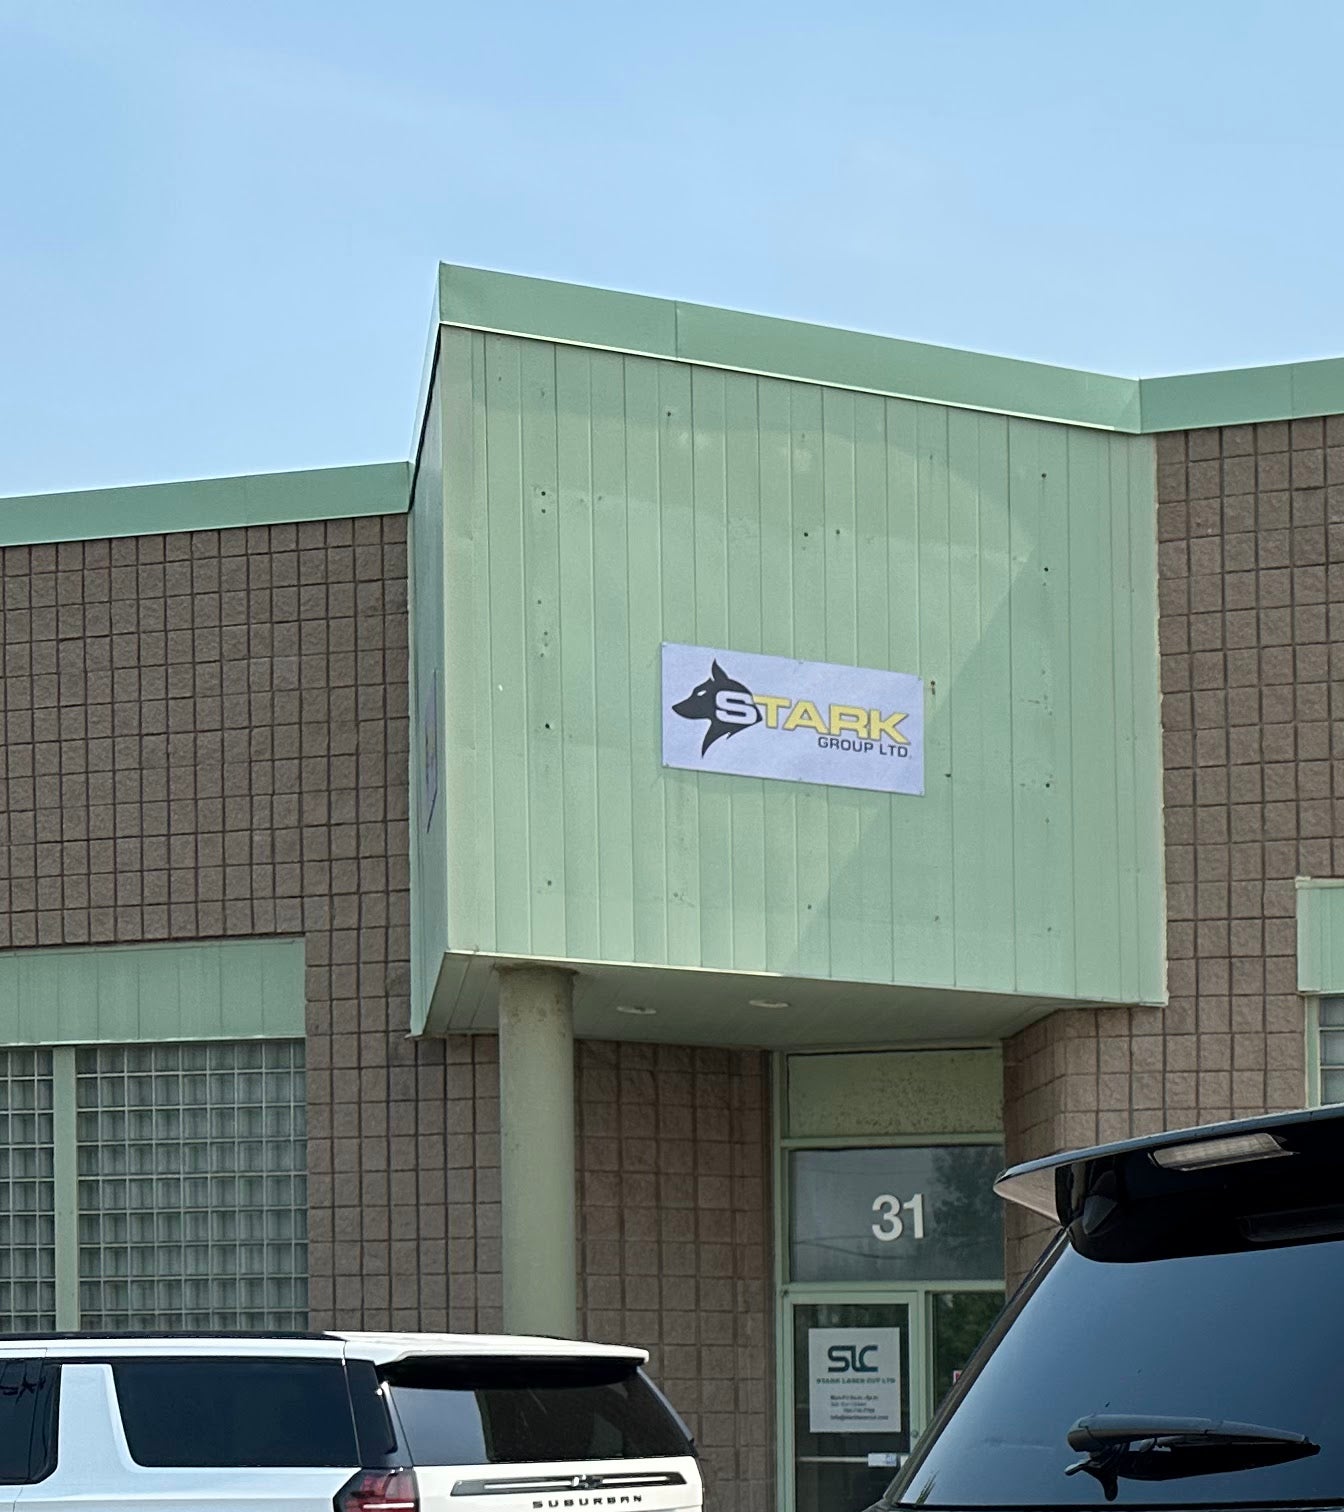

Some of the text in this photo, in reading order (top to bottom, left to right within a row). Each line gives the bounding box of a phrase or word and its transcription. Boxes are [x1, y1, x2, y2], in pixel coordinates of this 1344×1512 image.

[714, 690, 911, 745] STARK
[817, 736, 908, 758] GROUP LTD
[871, 1193, 925, 1242] 31
[827, 1345, 879, 1373] SLC
[532, 1495, 642, 1509] SUBURBAN
